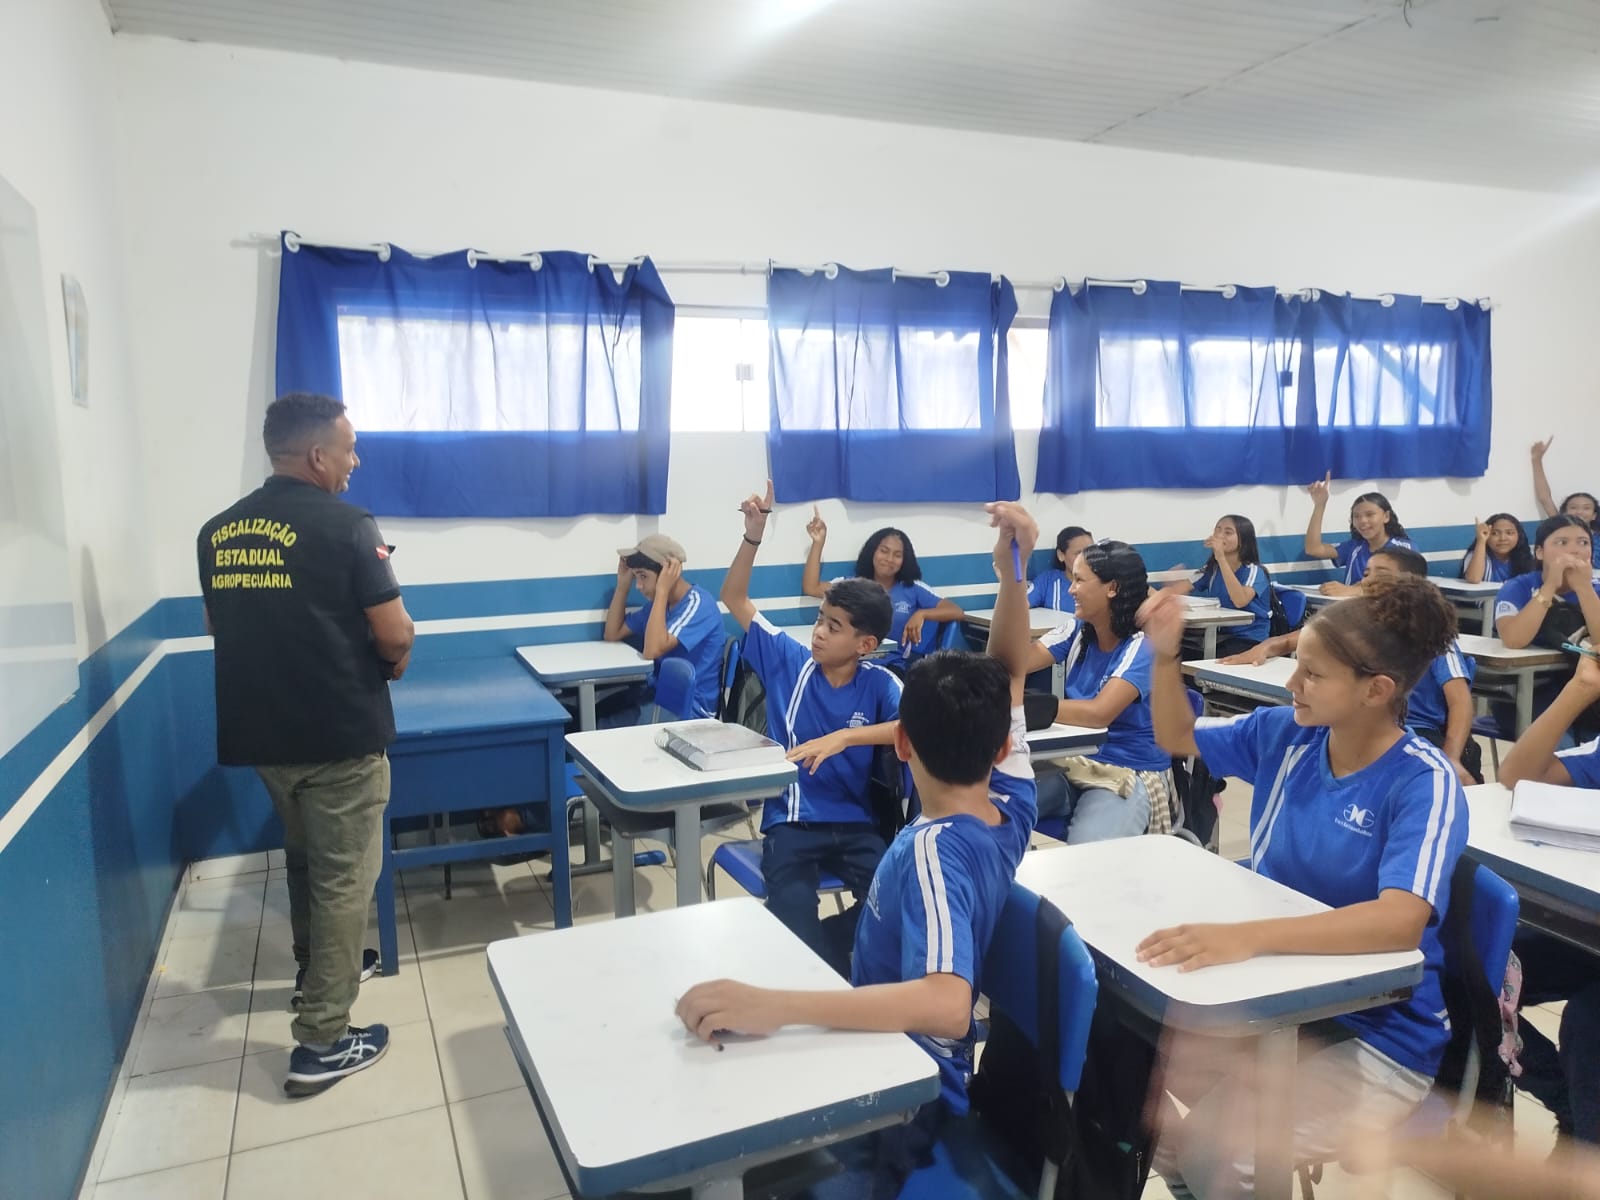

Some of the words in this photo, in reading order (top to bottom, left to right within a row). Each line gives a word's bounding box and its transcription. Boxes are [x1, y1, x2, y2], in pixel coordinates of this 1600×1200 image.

[211, 518, 297, 548] FISCALIZAÇÃO
[216, 548, 284, 567] ESTADUAL
[212, 570, 292, 589] AGROPECUÁRIA
